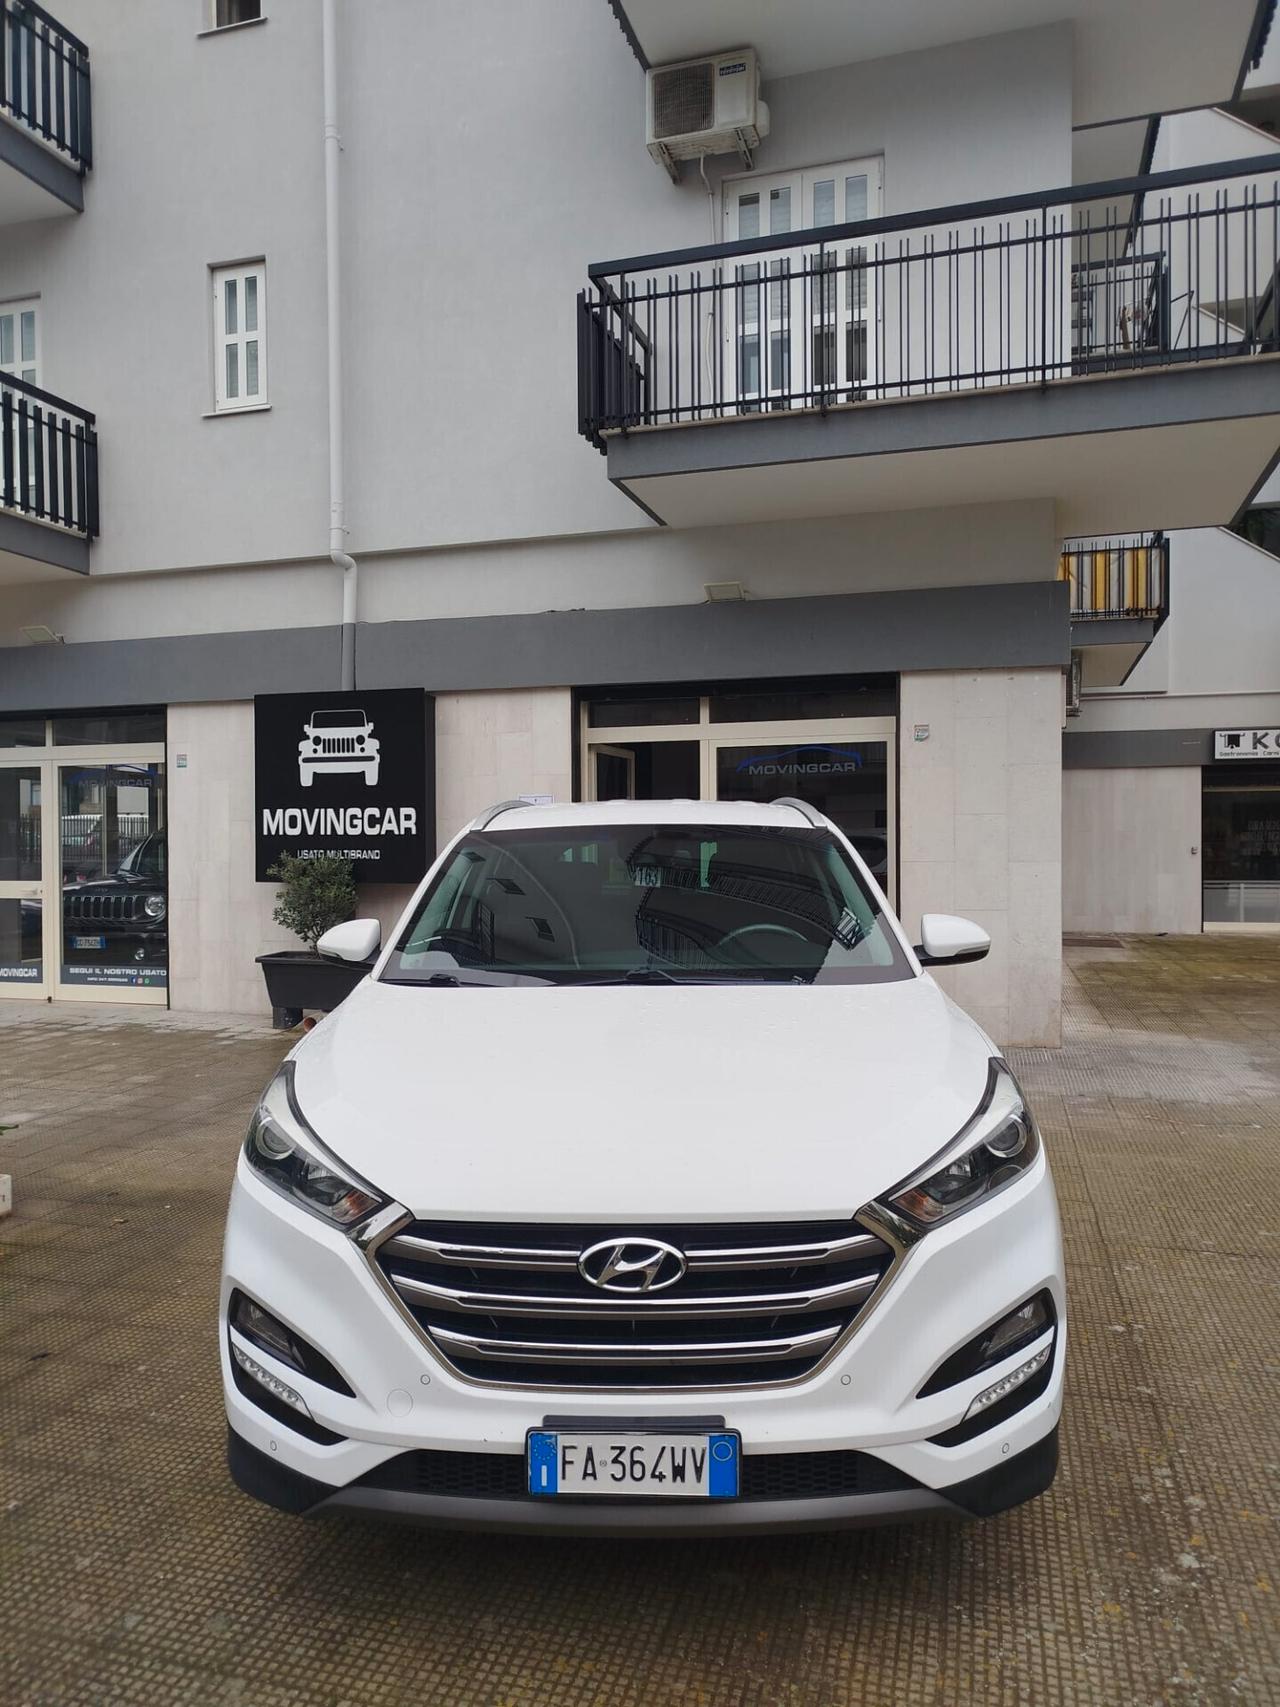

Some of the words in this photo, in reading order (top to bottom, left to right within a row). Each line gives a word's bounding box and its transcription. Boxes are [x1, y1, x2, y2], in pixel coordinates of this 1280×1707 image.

[749, 762, 856, 775] MOVINGCAR
[263, 807, 417, 836] MOVINGCAR
[103, 968, 137, 976] NOSTRO
